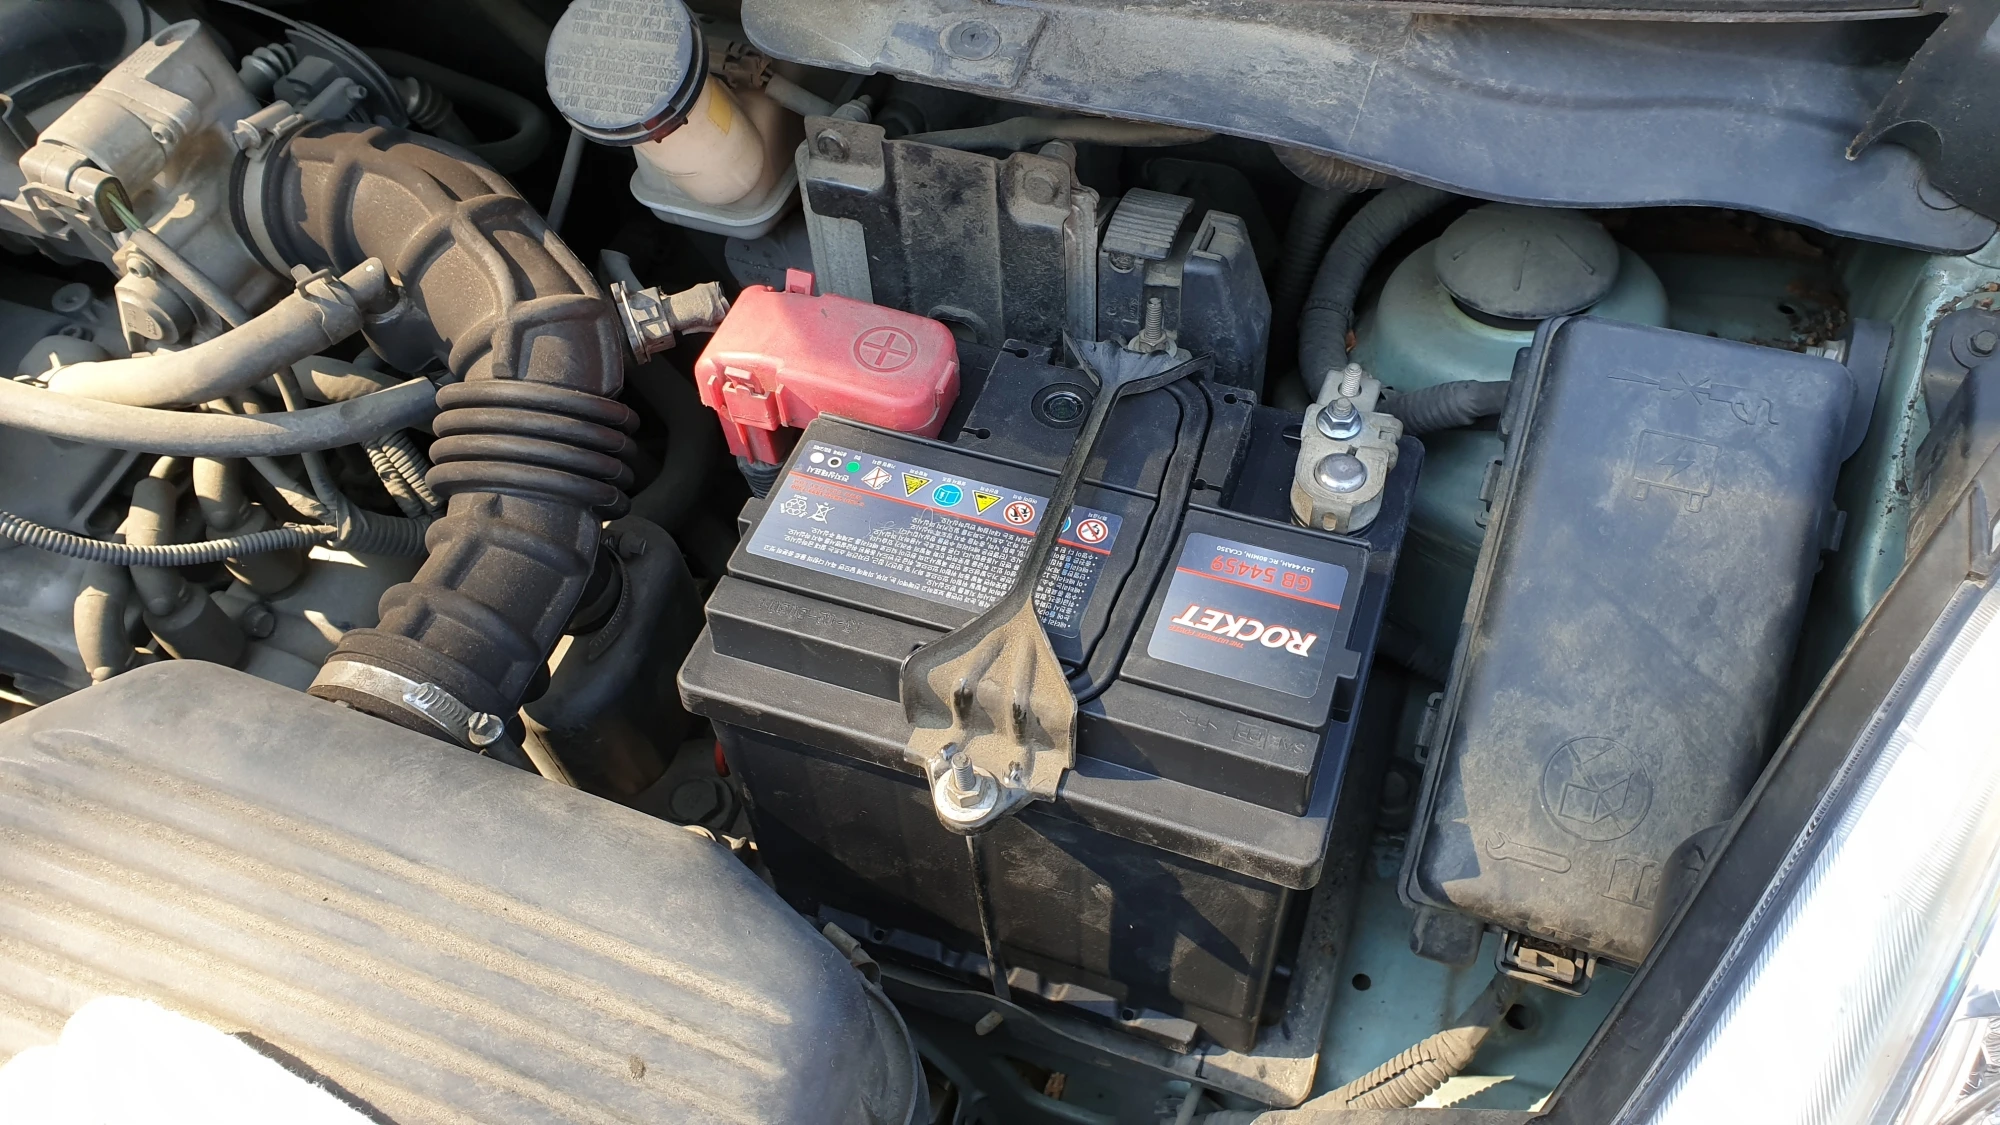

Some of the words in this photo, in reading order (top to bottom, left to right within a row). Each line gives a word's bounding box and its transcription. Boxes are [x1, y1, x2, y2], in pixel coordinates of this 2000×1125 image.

[1210, 556, 1276, 583] 54459
[1281, 572, 1312, 592] GB
[1170, 604, 1317, 657] ROCKET
